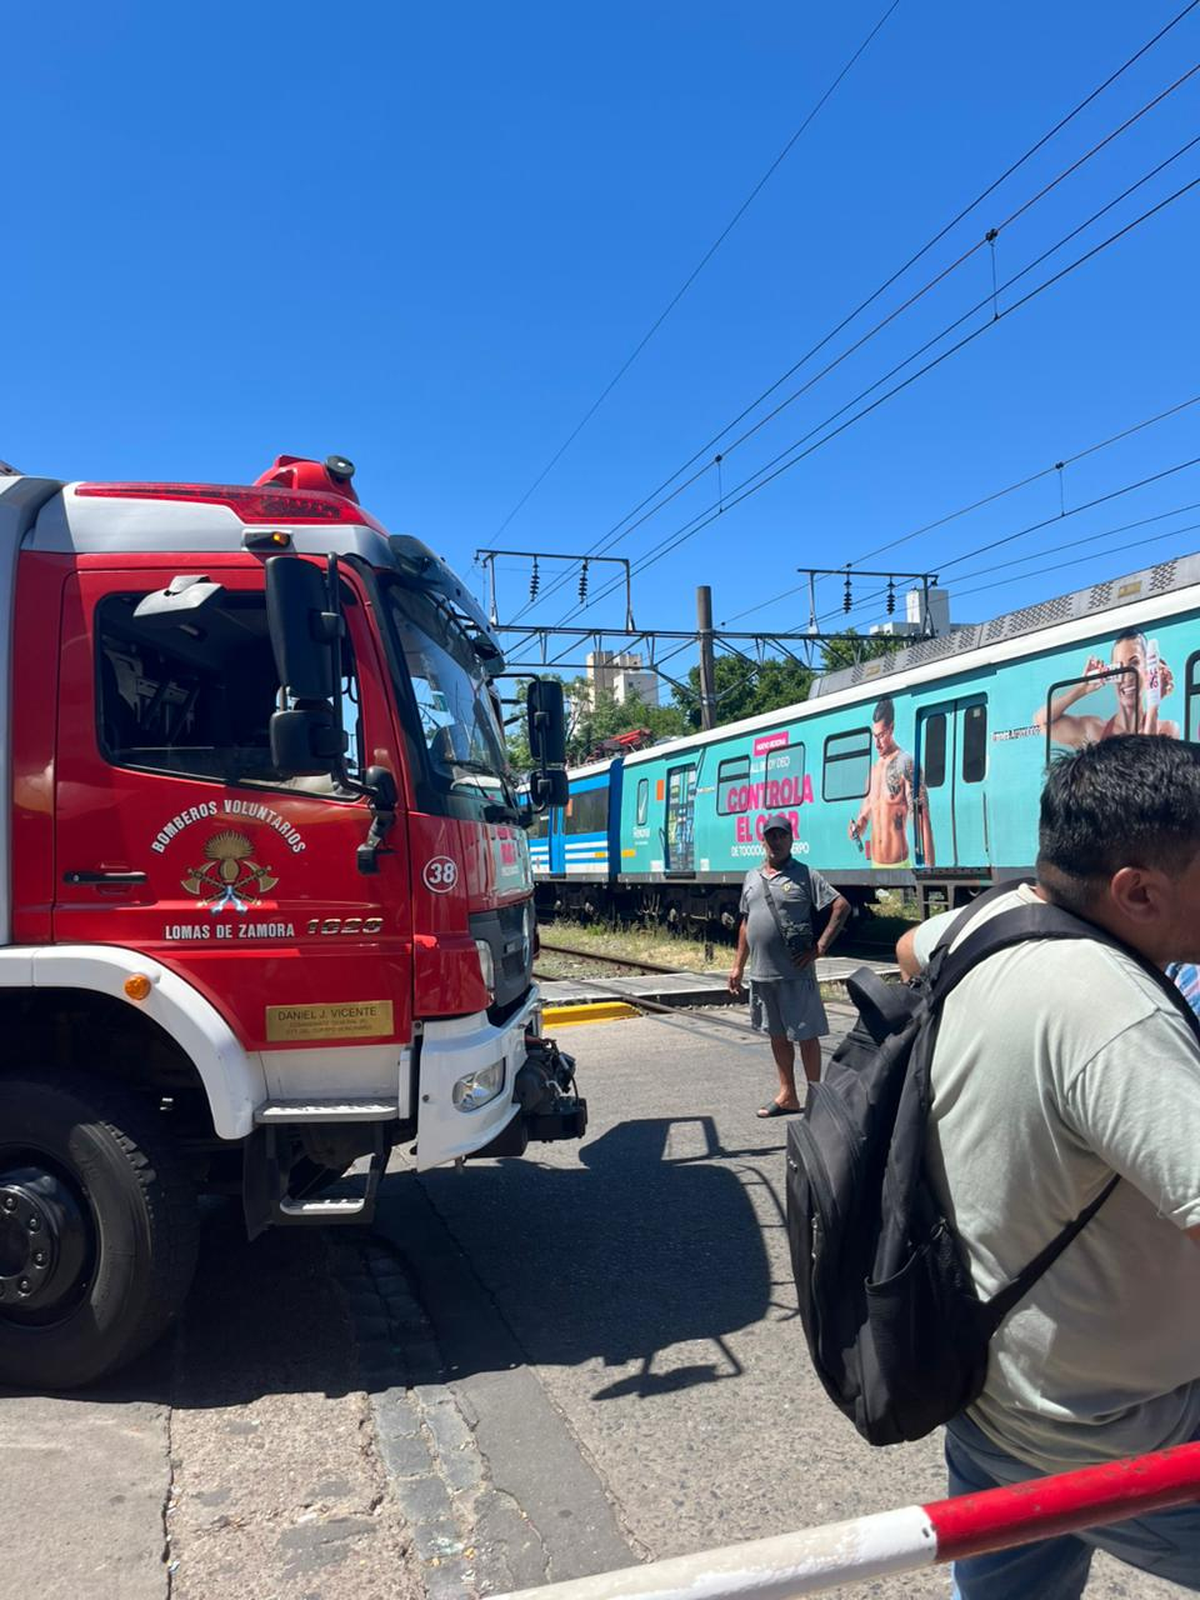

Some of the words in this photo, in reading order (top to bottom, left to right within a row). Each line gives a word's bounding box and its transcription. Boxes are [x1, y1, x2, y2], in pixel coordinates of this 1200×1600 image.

[727, 774, 814, 813] CONTROLA
[151, 801, 218, 854] BOMBEROS
[224, 800, 306, 853] VOLUNTARIOS
[736, 816, 753, 842] EL
[755, 811, 800, 841] OR
[429, 863, 454, 883] 38
[165, 925, 210, 939] LOMAS
[216, 924, 233, 938] DE
[239, 923, 295, 938] ZAMORA
[278, 1010, 317, 1021] DANIEL
[319, 1010, 327, 1019] J.
[330, 1006, 377, 1018] VICENTE
